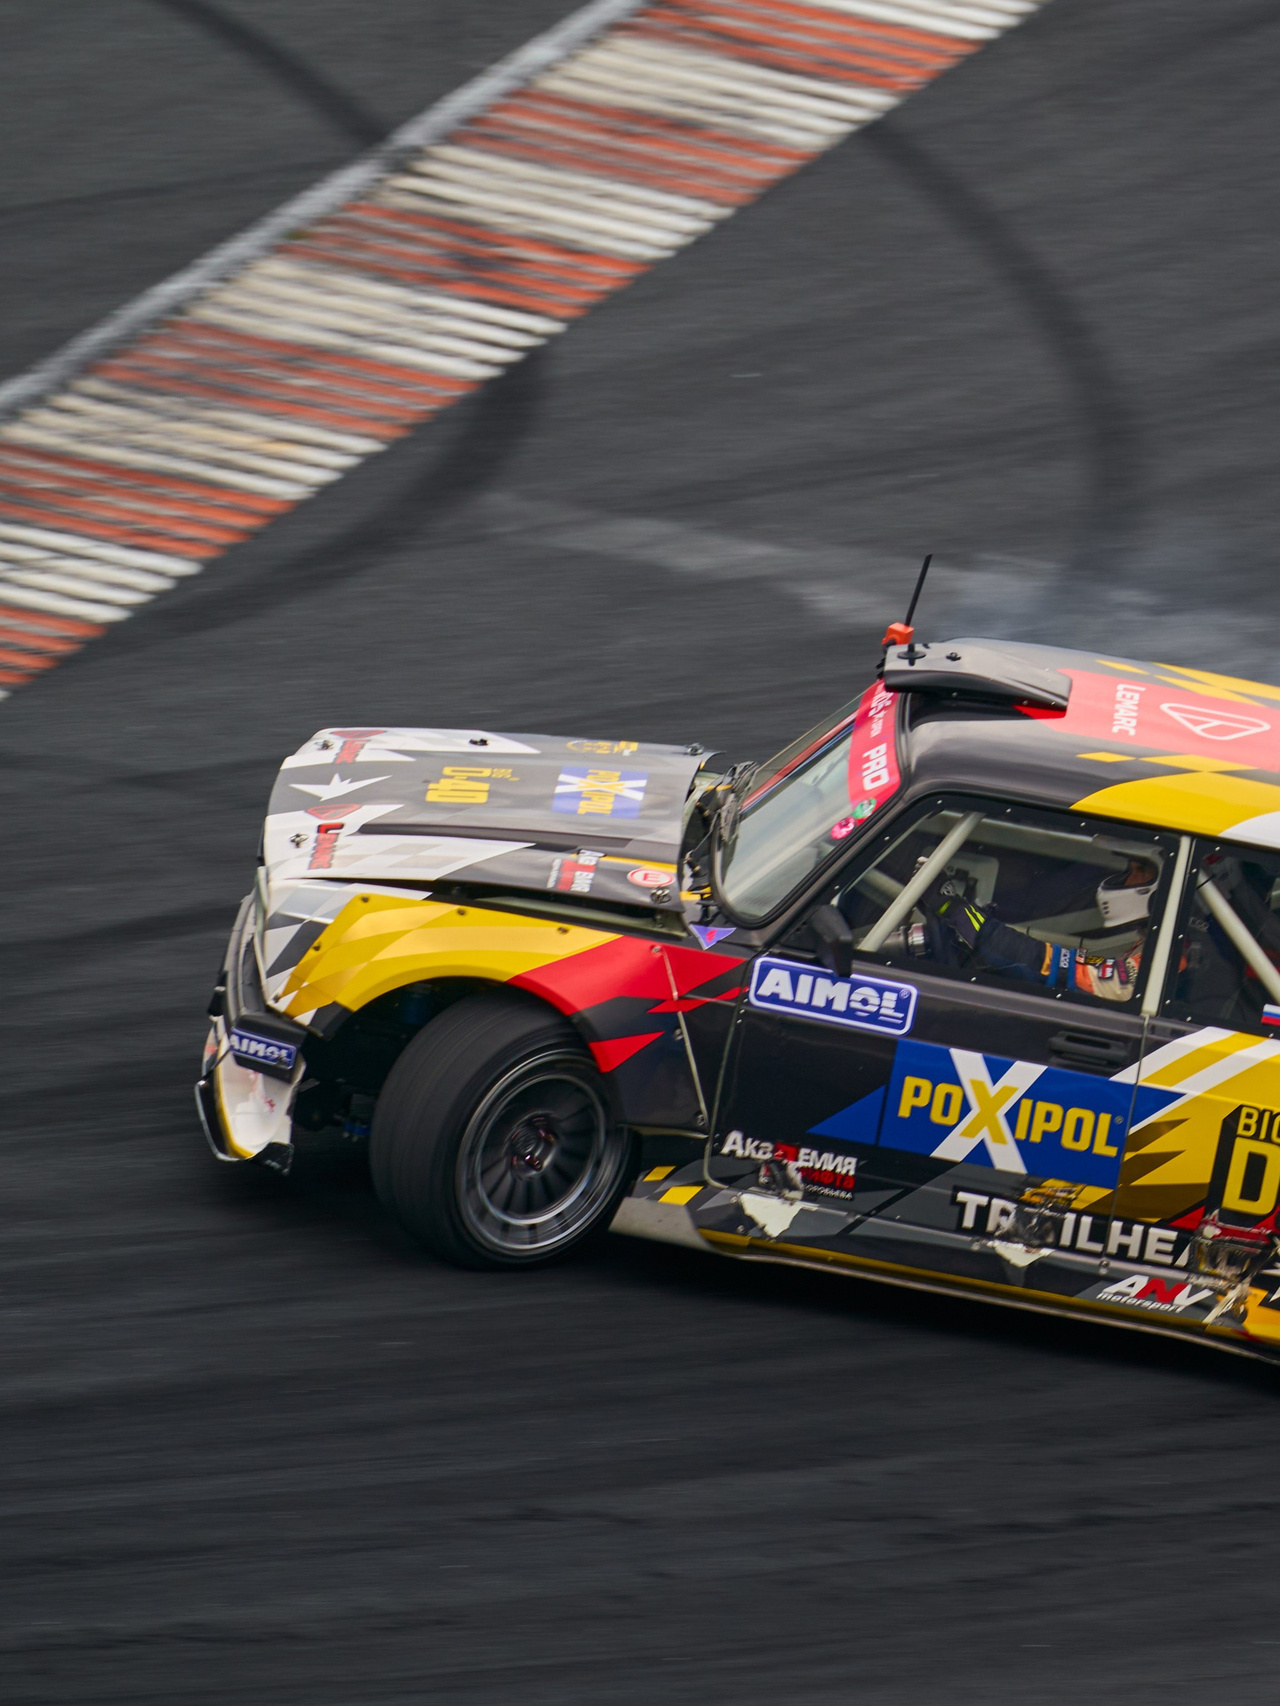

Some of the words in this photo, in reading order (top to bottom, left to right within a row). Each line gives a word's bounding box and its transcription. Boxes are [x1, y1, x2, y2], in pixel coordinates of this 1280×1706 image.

[1111, 683, 1147, 736] LEMARC
[574, 769, 626, 815] POXIPOL
[862, 743, 890, 791] PRO
[756, 968, 905, 1023] AIMOL
[898, 1075, 1119, 1158] POXIPOL
[1096, 1291, 1185, 1313] motorsport
